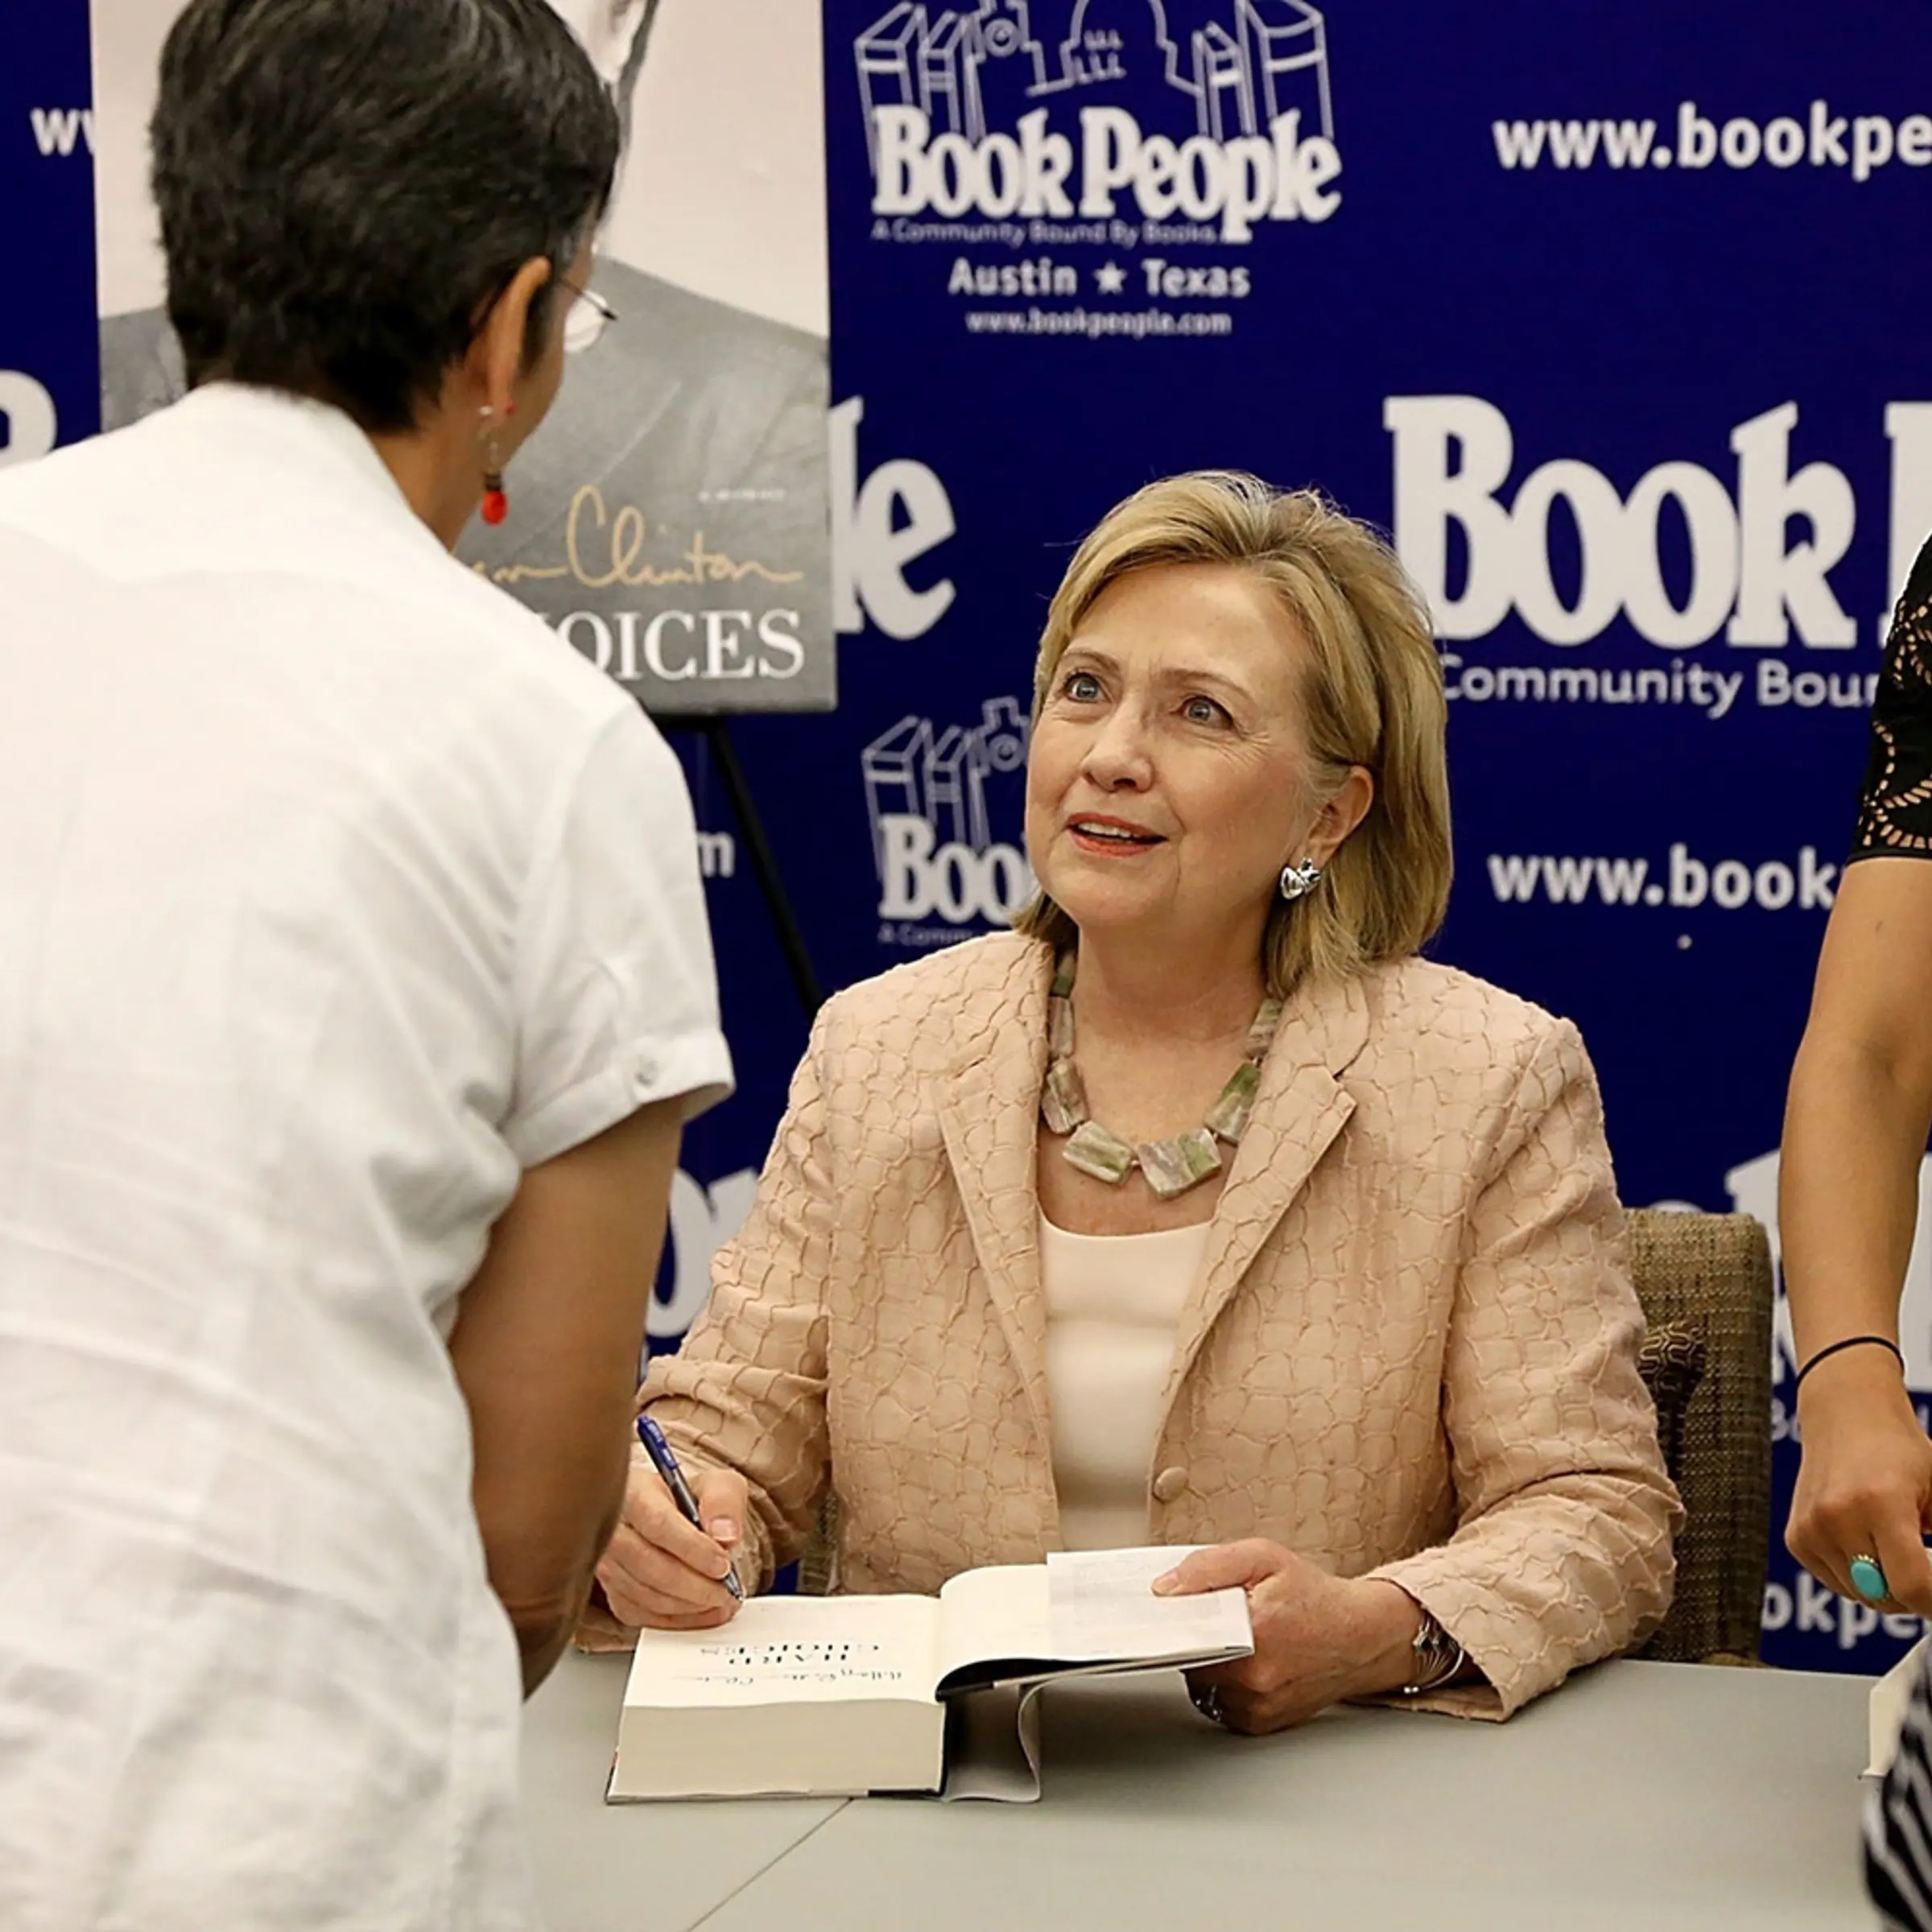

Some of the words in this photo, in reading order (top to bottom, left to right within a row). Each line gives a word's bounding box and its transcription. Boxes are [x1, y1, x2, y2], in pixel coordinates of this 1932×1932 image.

[873, 105, 1074, 218] Book
[1079, 106, 1342, 243] People
[948, 256, 1077, 296] Austin
[1141, 258, 1251, 298] Texas
[966, 306, 1232, 340] www.bookpeople.com
[1382, 394, 1857, 650] Book
[538, 608, 805, 681] OICES
